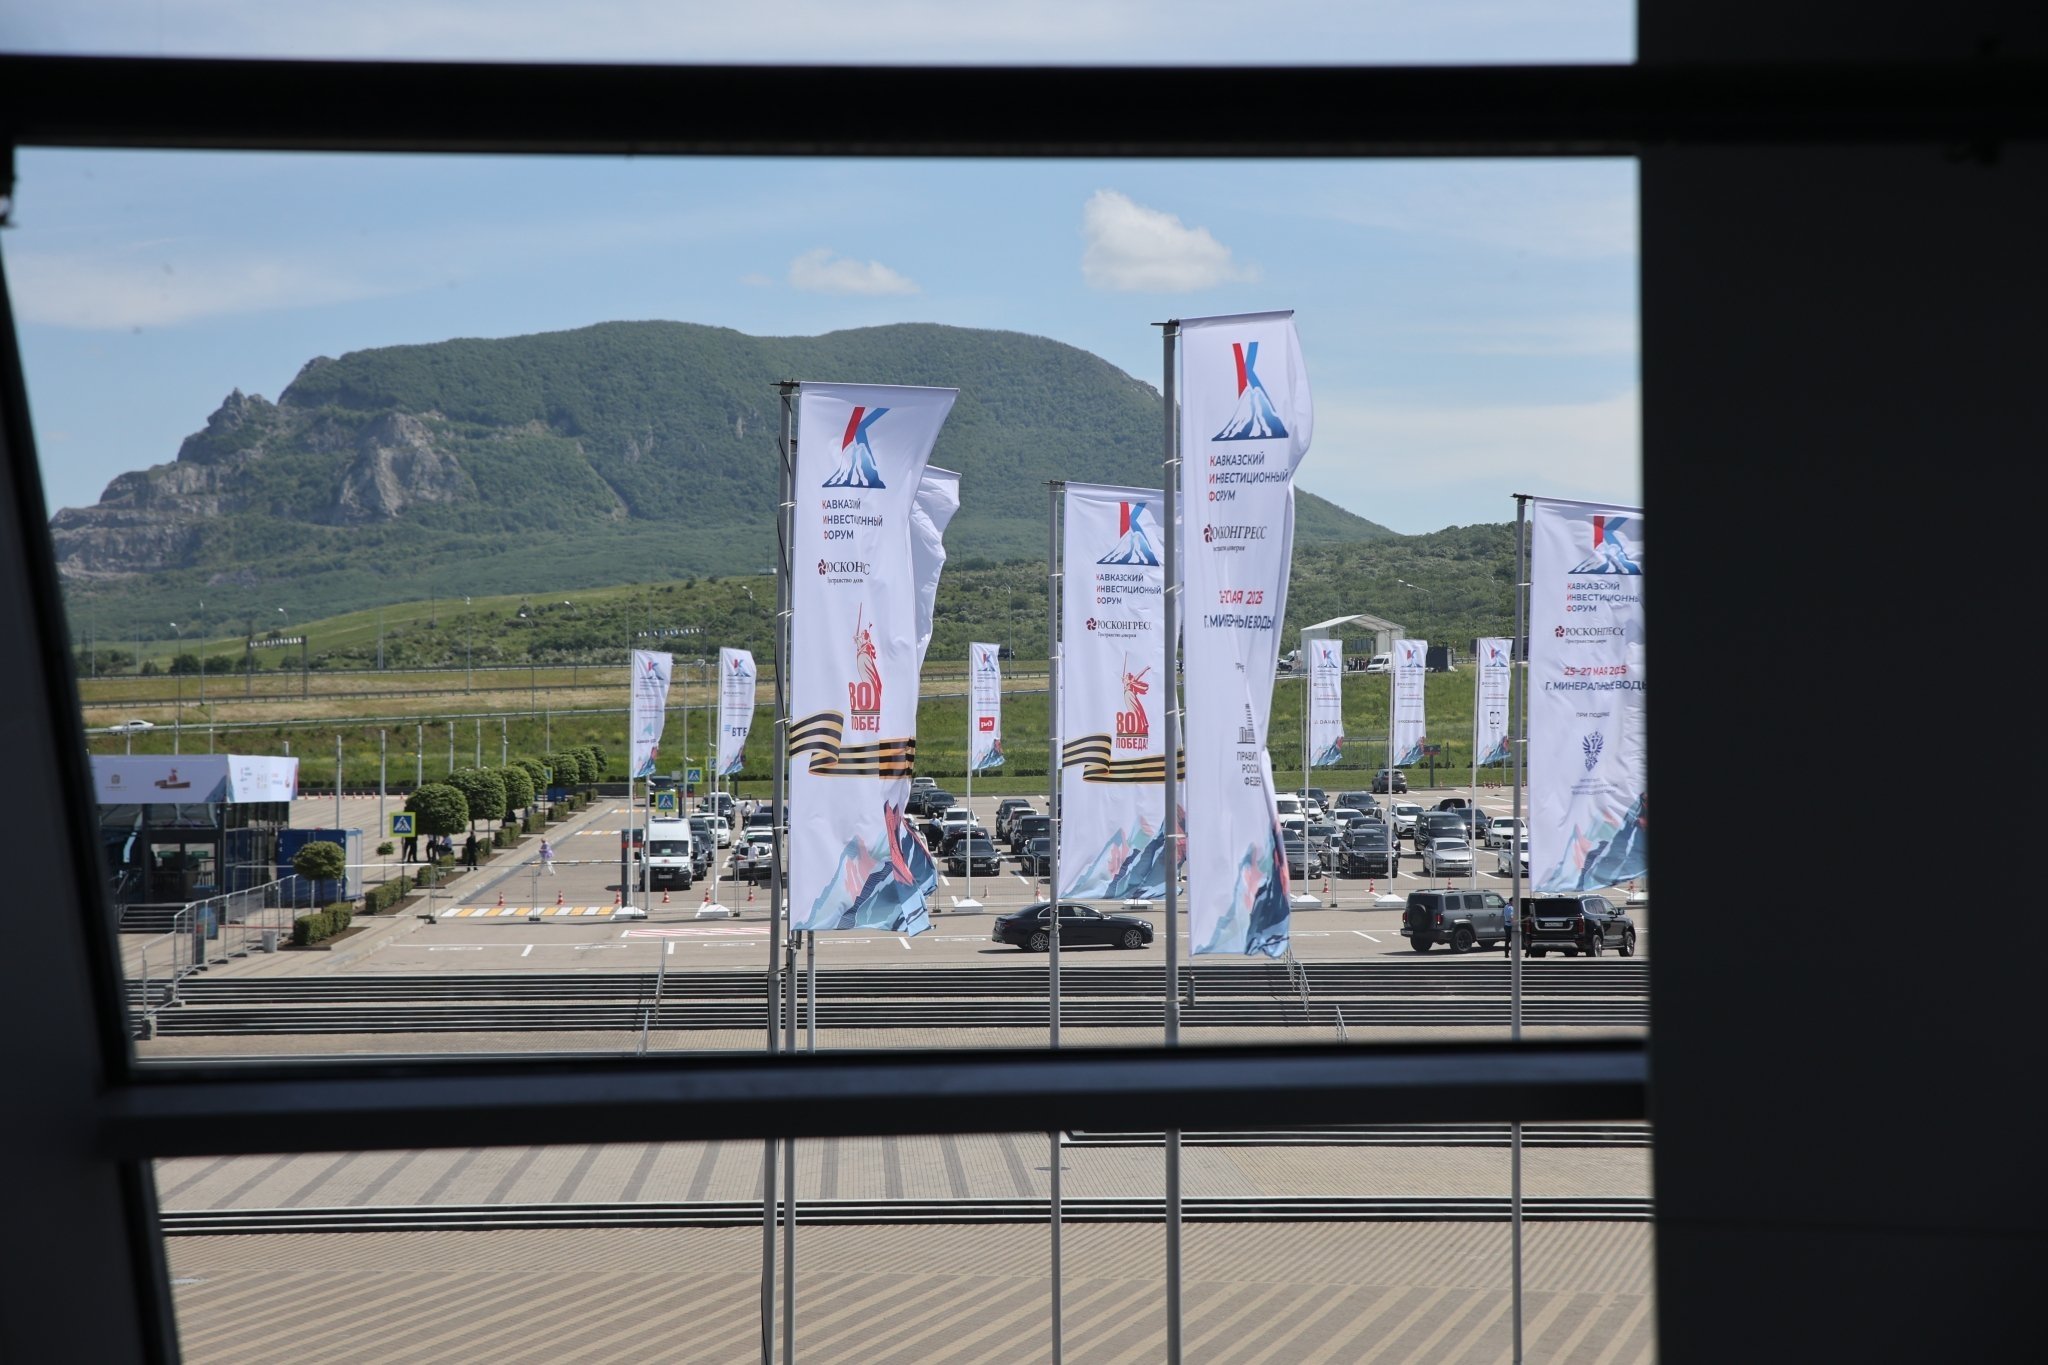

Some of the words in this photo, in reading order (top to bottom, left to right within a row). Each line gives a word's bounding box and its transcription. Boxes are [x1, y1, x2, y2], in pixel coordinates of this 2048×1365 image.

[1209, 451, 1265, 467] КАВКАЗСКИЙ
[1209, 469, 1289, 485] ИНВЕСТИЦИОННЫЙ
[1096, 573, 1144, 582] КАВКАЗСКИЙ
[1116, 712, 1136, 734] 80
